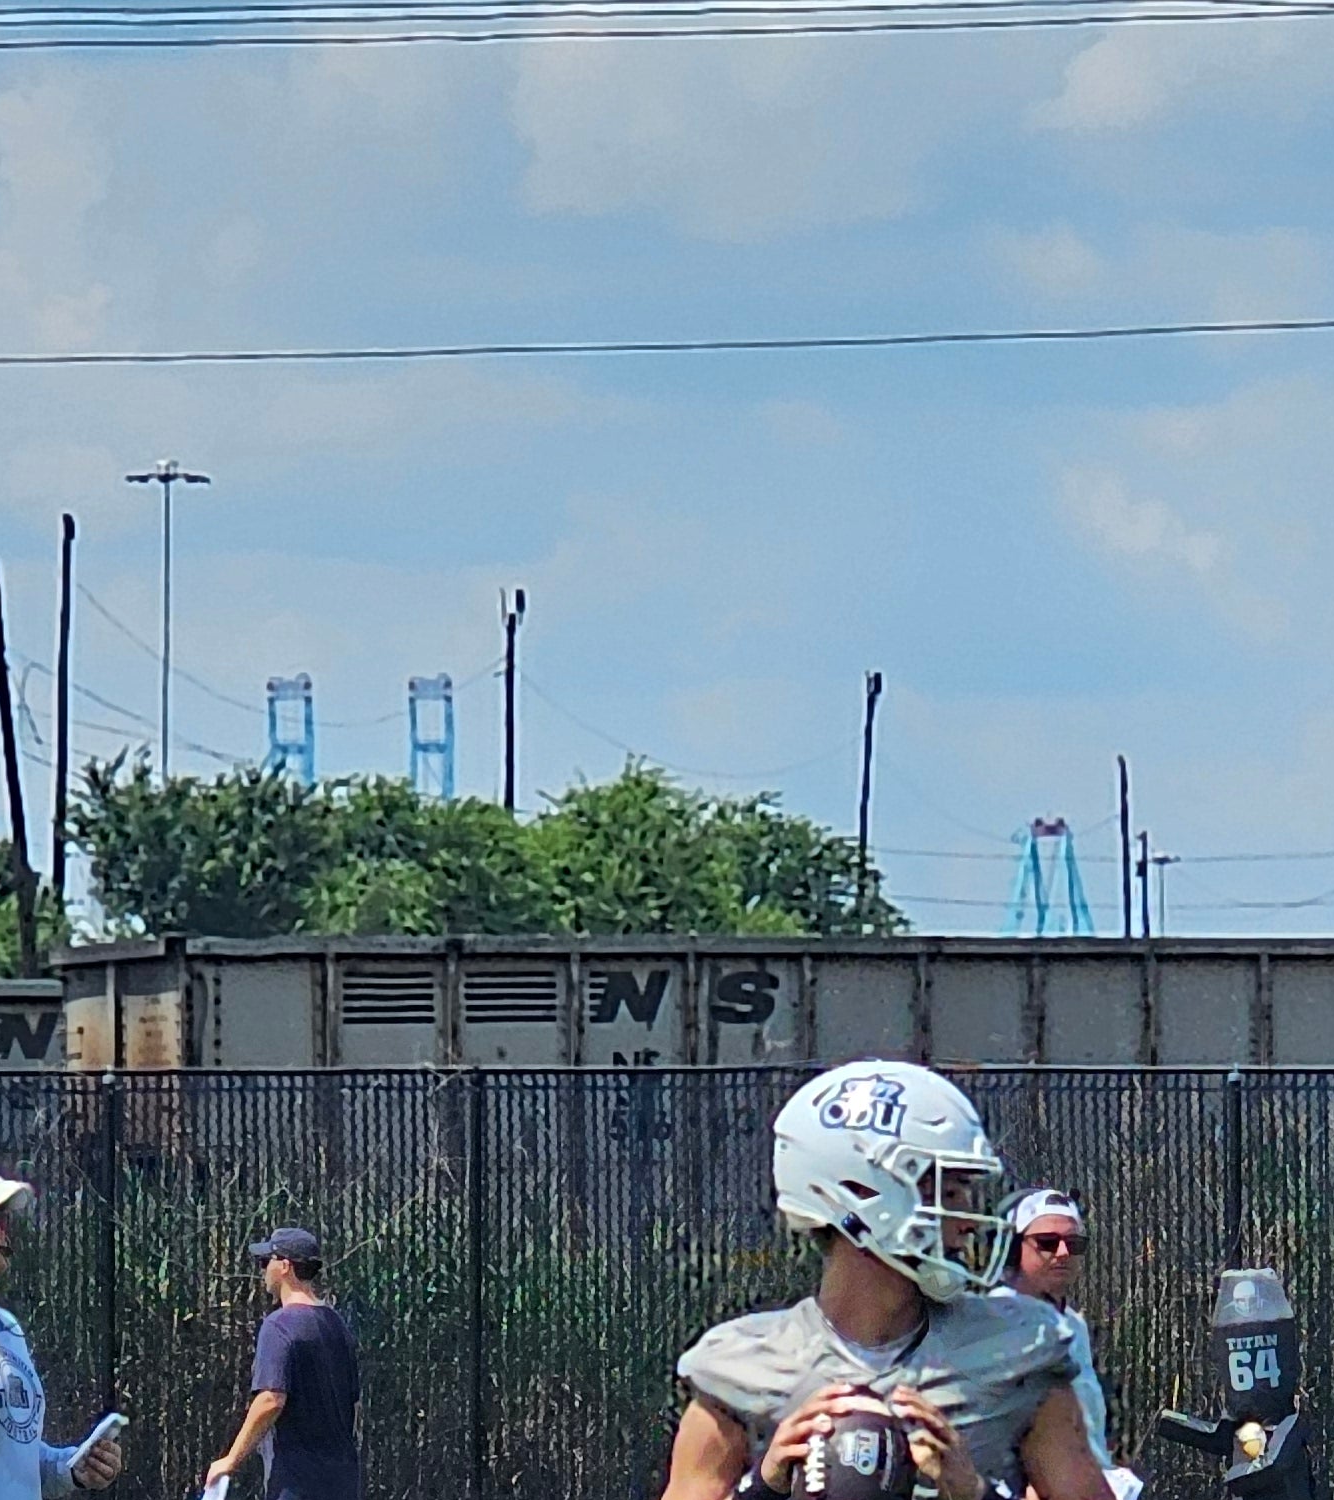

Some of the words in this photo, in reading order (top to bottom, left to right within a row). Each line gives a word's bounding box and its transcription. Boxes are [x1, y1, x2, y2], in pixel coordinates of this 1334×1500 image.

[709, 970, 780, 1025] S
[1225, 1333, 1279, 1351] TITAN
[1228, 1348, 1282, 1392] 64
